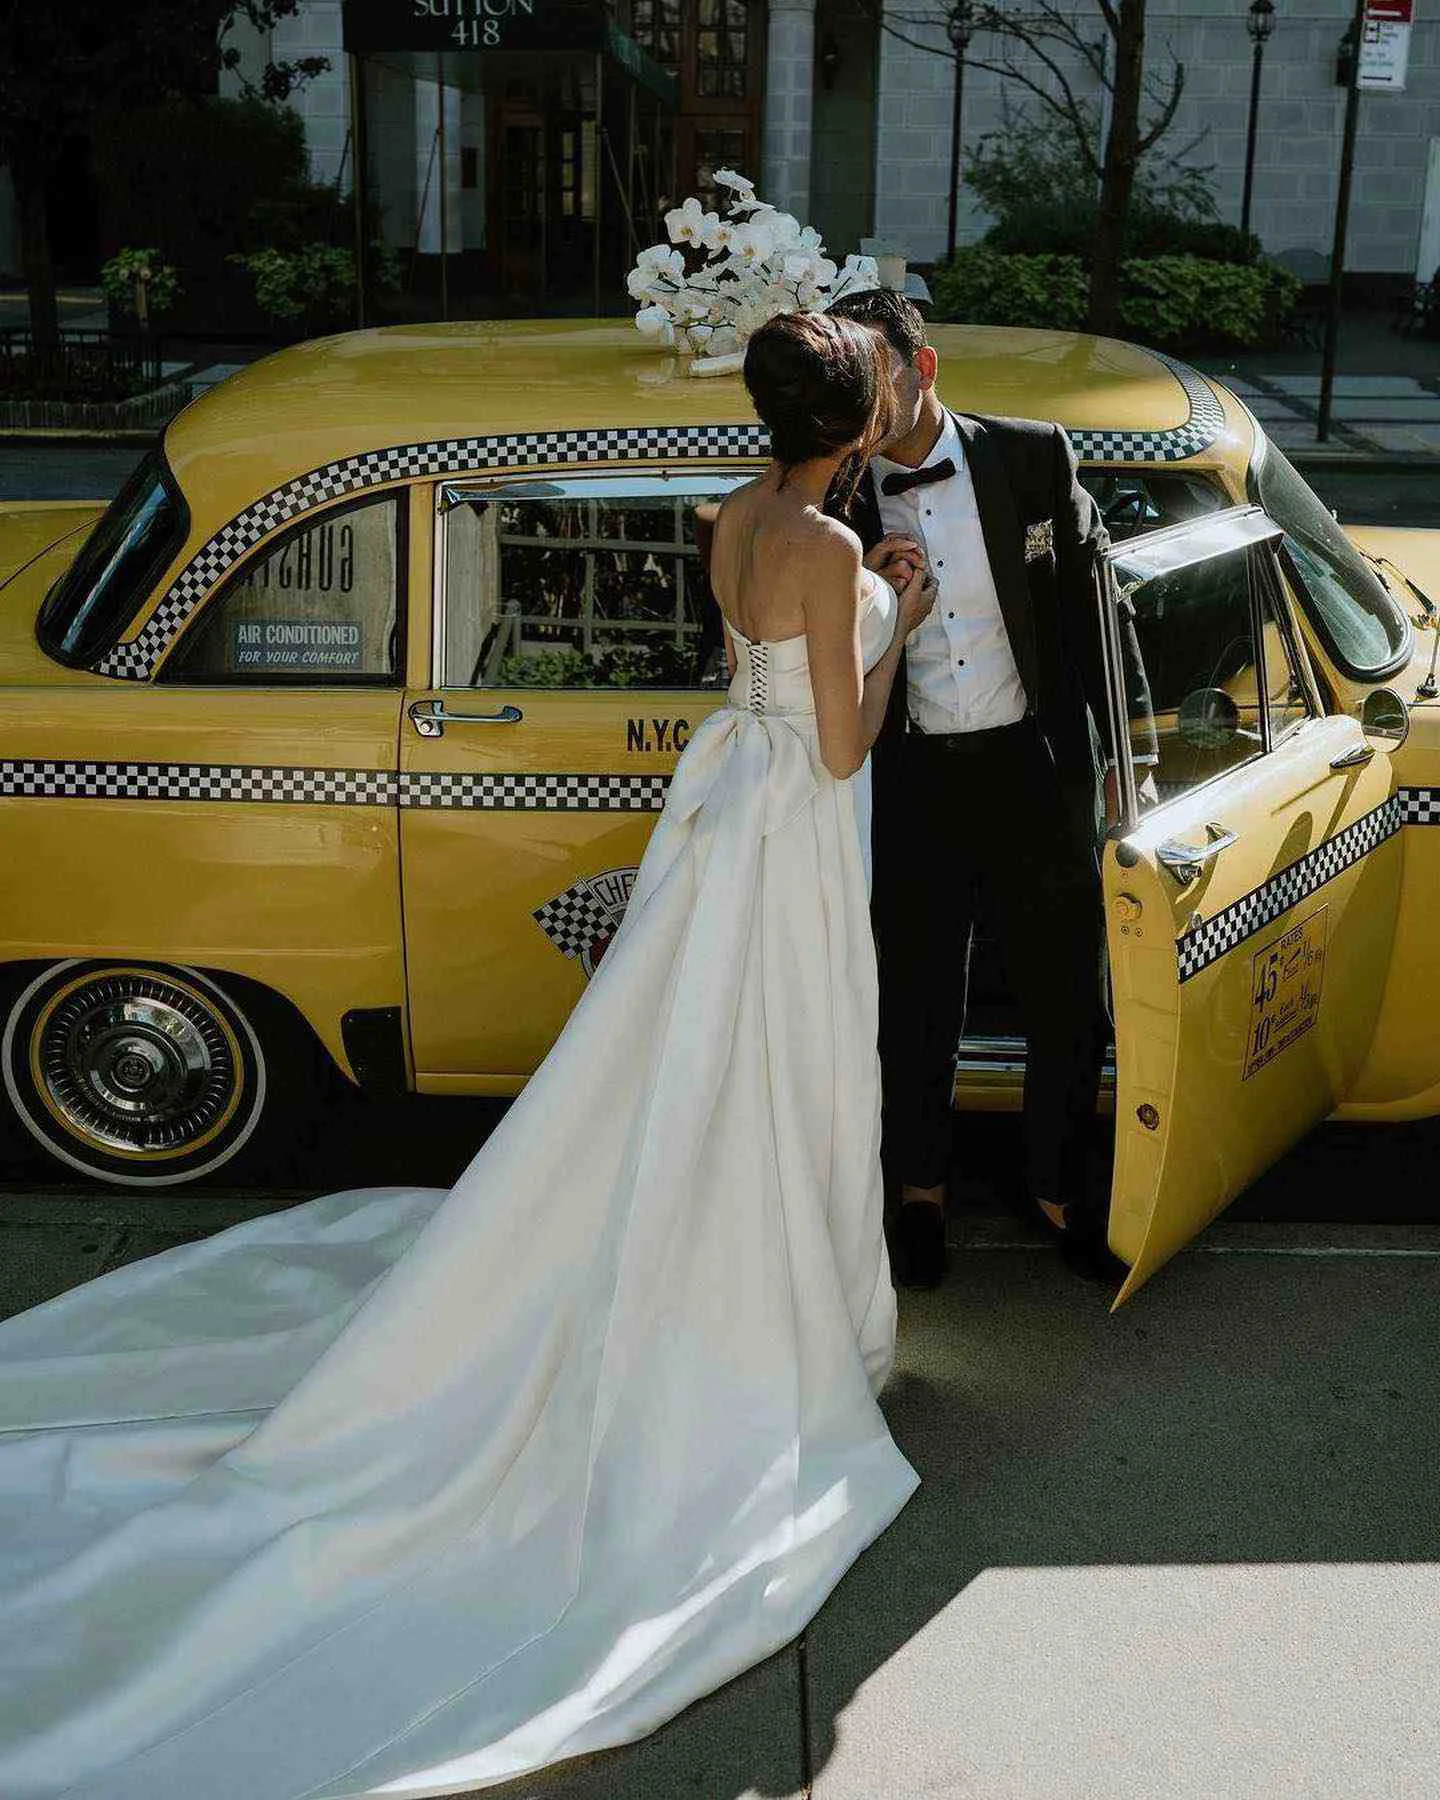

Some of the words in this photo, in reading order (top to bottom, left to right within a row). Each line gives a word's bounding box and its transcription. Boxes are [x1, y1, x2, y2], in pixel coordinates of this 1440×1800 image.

[450, 19, 501, 46] 418
[238, 624, 261, 644] AIR
[266, 624, 359, 645] CONDITIONED
[238, 650, 262, 663] FOR
[267, 650, 298, 664] YOUR
[302, 650, 360, 665] COMFORT
[594, 873, 638, 906] CHE
